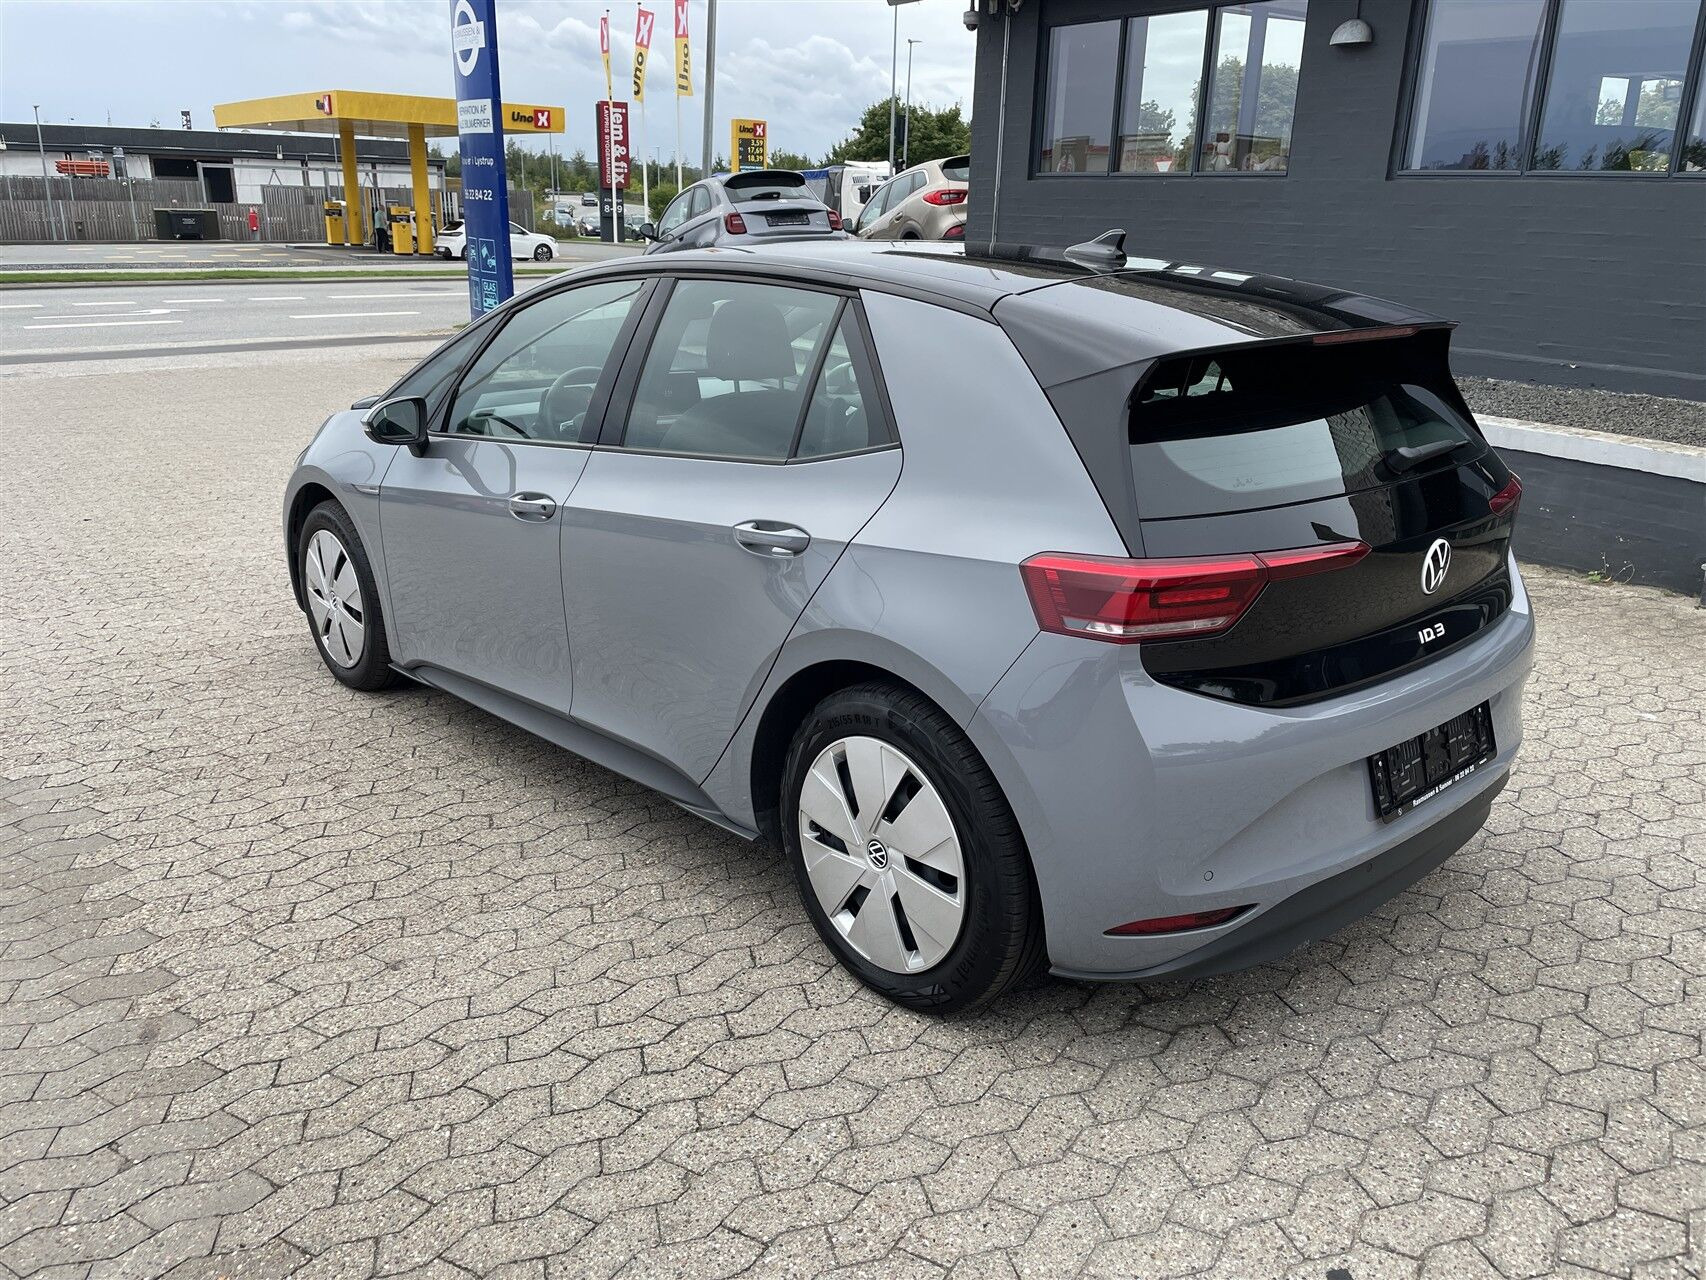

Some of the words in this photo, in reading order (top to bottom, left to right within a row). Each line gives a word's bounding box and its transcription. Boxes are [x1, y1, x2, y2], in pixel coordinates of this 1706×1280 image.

[511, 111, 534, 123] Uno
[474, 156, 494, 166] Lystrup
[612, 161, 628, 184] fix
